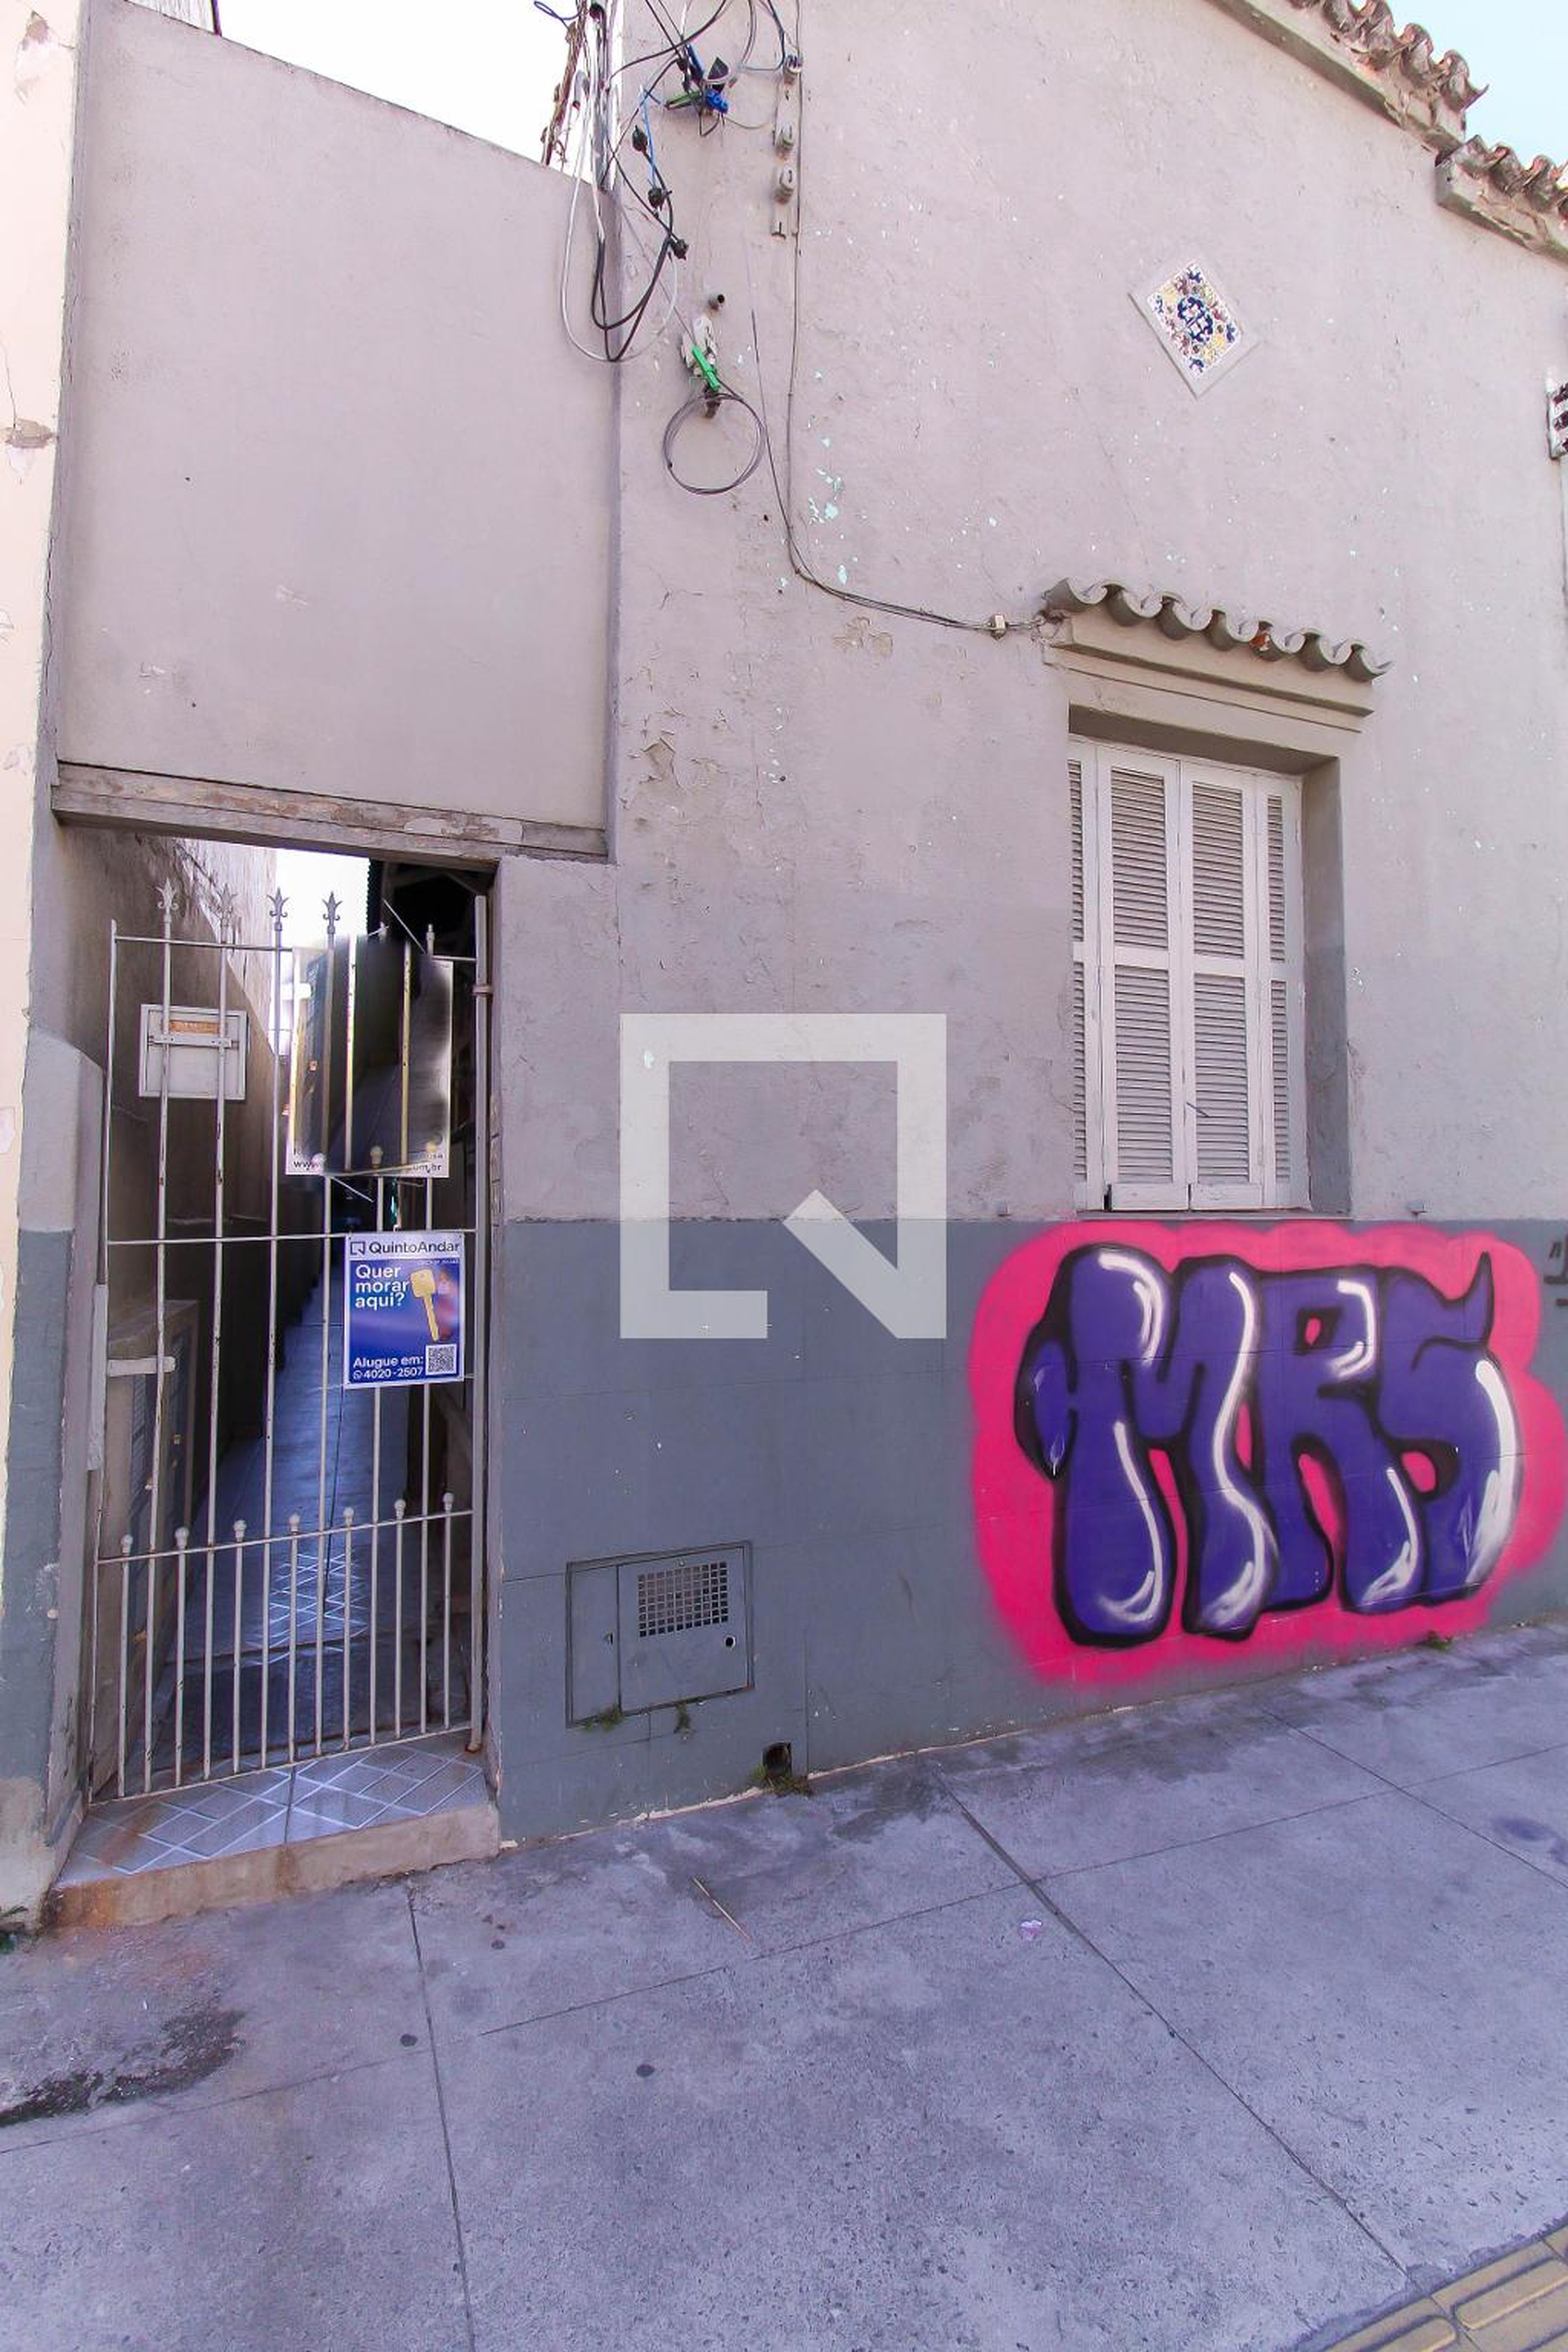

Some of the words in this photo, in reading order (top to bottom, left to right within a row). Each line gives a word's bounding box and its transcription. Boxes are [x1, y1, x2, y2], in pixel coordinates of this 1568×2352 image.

[369, 1241, 459, 1254] QuintoAndar
[356, 1265, 401, 1279] Quer
[356, 1281, 409, 1293] morar
[355, 1292, 405, 1310] aqui?
[353, 1358, 399, 1369] Alugue
[401, 1356, 423, 1365] em:
